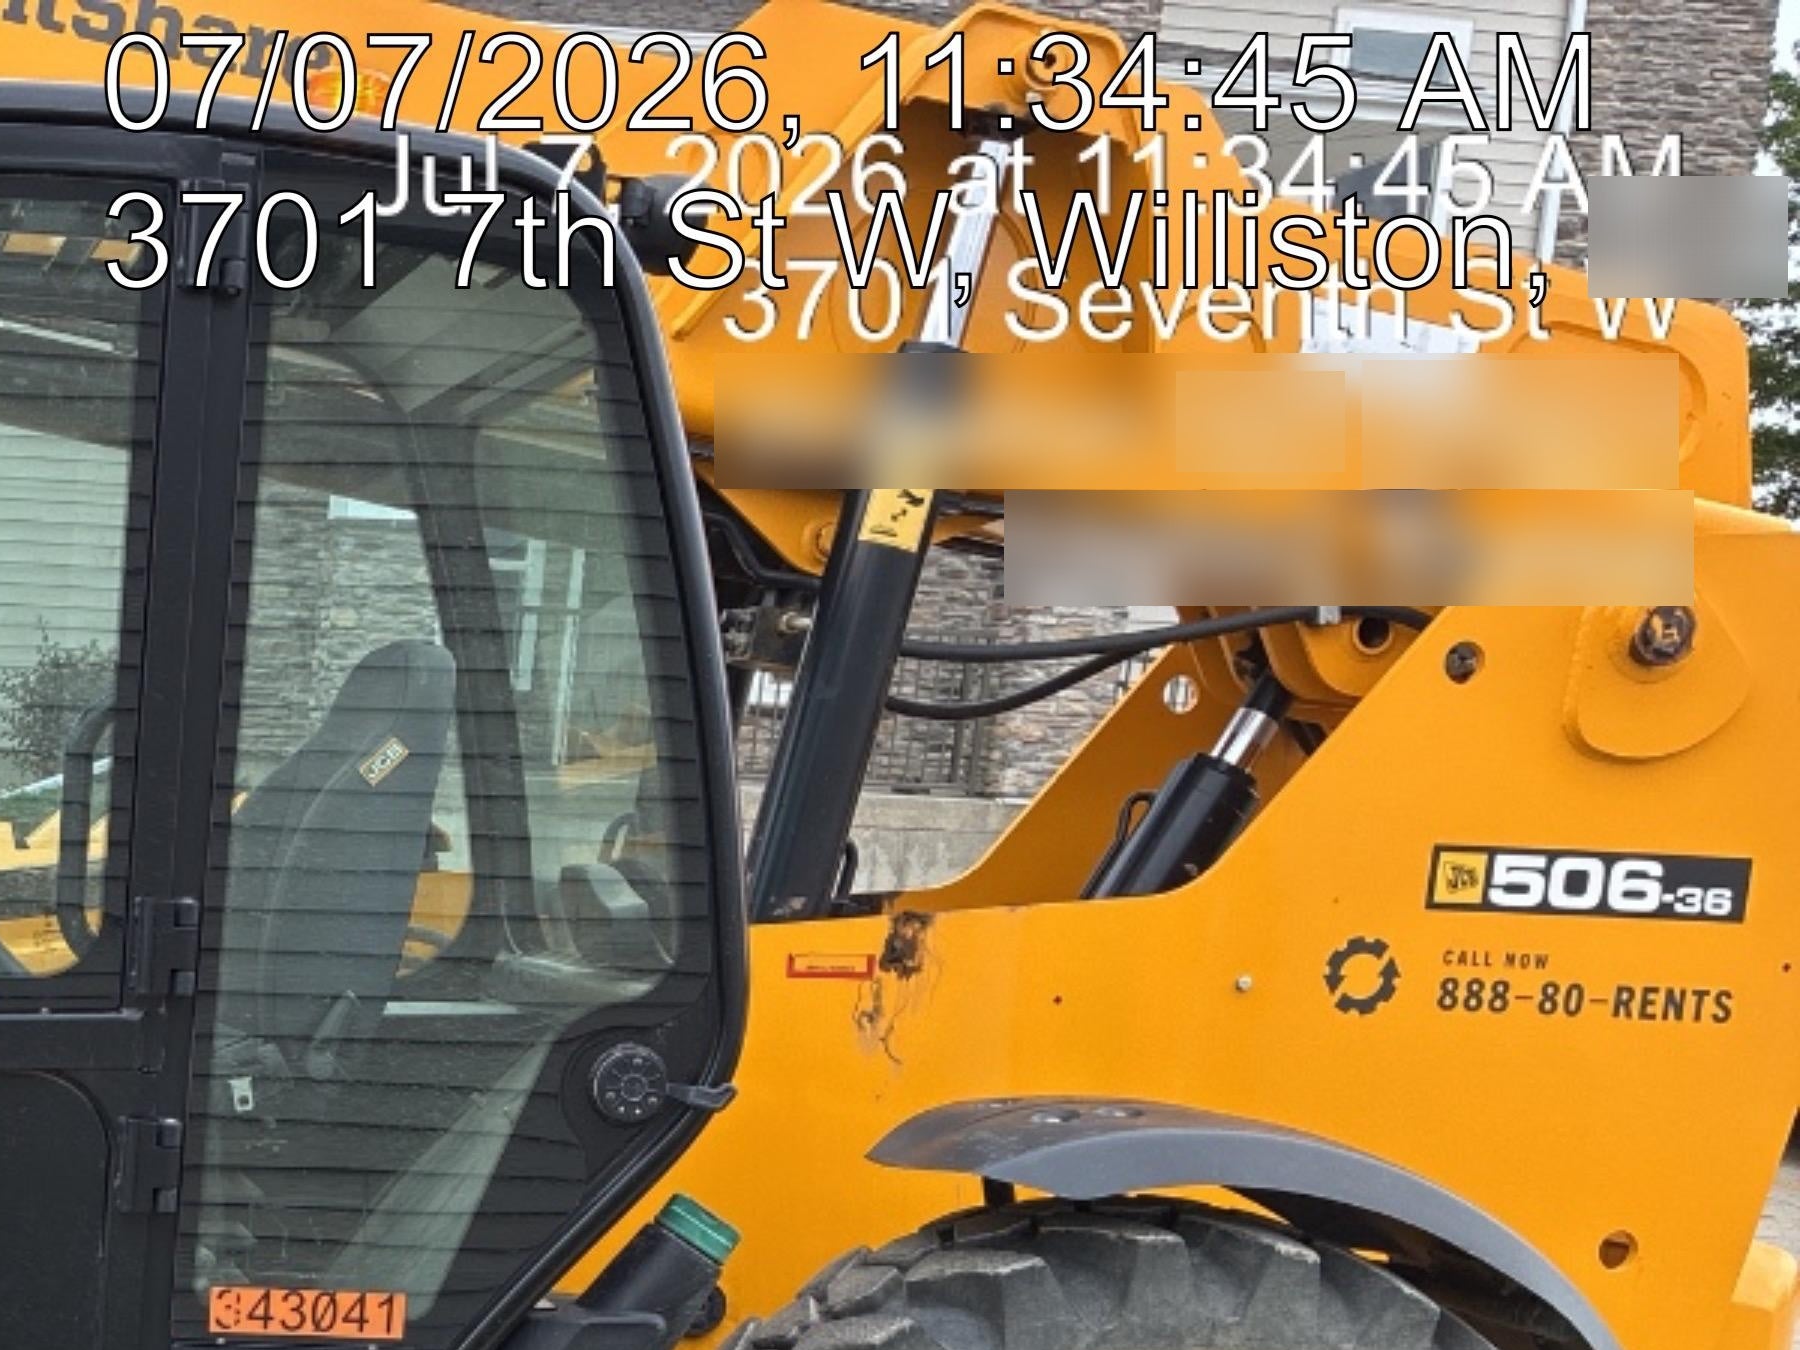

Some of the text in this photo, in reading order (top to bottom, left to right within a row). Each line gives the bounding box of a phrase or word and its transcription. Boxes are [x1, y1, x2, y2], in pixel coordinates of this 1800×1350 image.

[1488, 853, 1733, 916] 506-36
[1441, 950, 1493, 968] CALL
[1436, 977, 1734, 1024] 888-80-RENTS
